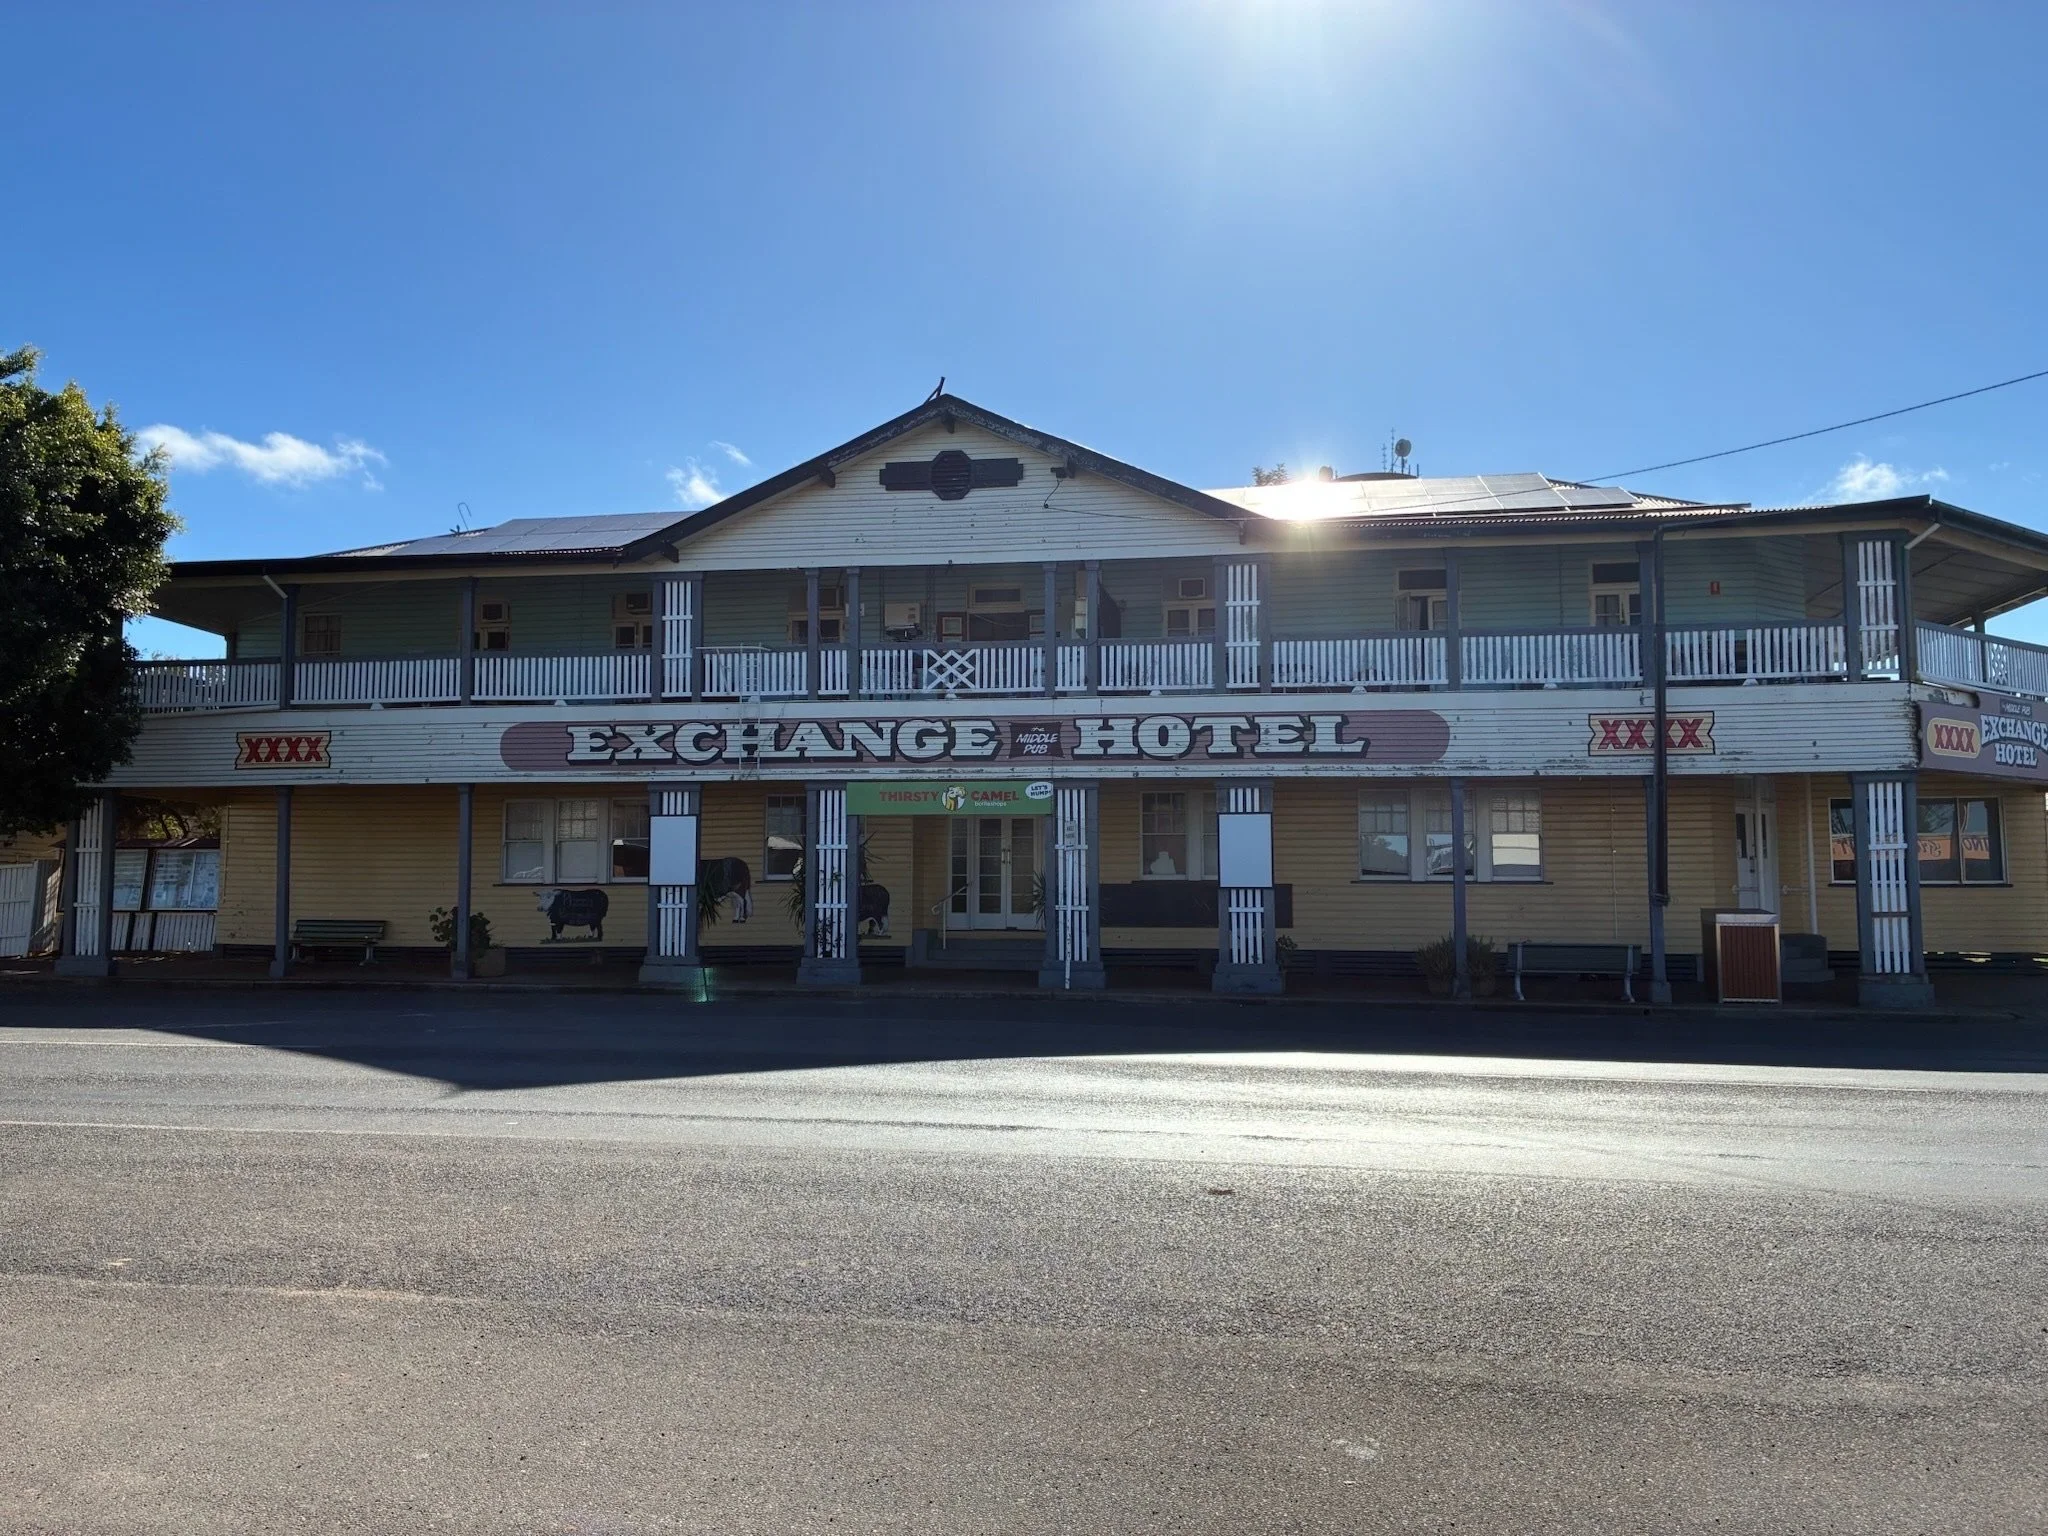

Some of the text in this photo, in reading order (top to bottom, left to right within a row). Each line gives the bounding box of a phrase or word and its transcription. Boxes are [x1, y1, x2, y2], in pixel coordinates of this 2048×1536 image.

[566, 713, 1370, 766] EXCHANGE HOTEL
[1016, 733, 1058, 743] MIDDLE
[1934, 724, 1975, 753] XXXX
[1980, 714, 2048, 752] EXCHANGE
[245, 738, 323, 761] XXXX
[1023, 744, 1048, 754] PUB
[1995, 743, 2038, 767] HOTEL
[879, 790, 1019, 802] THIRSTY CAMEL
